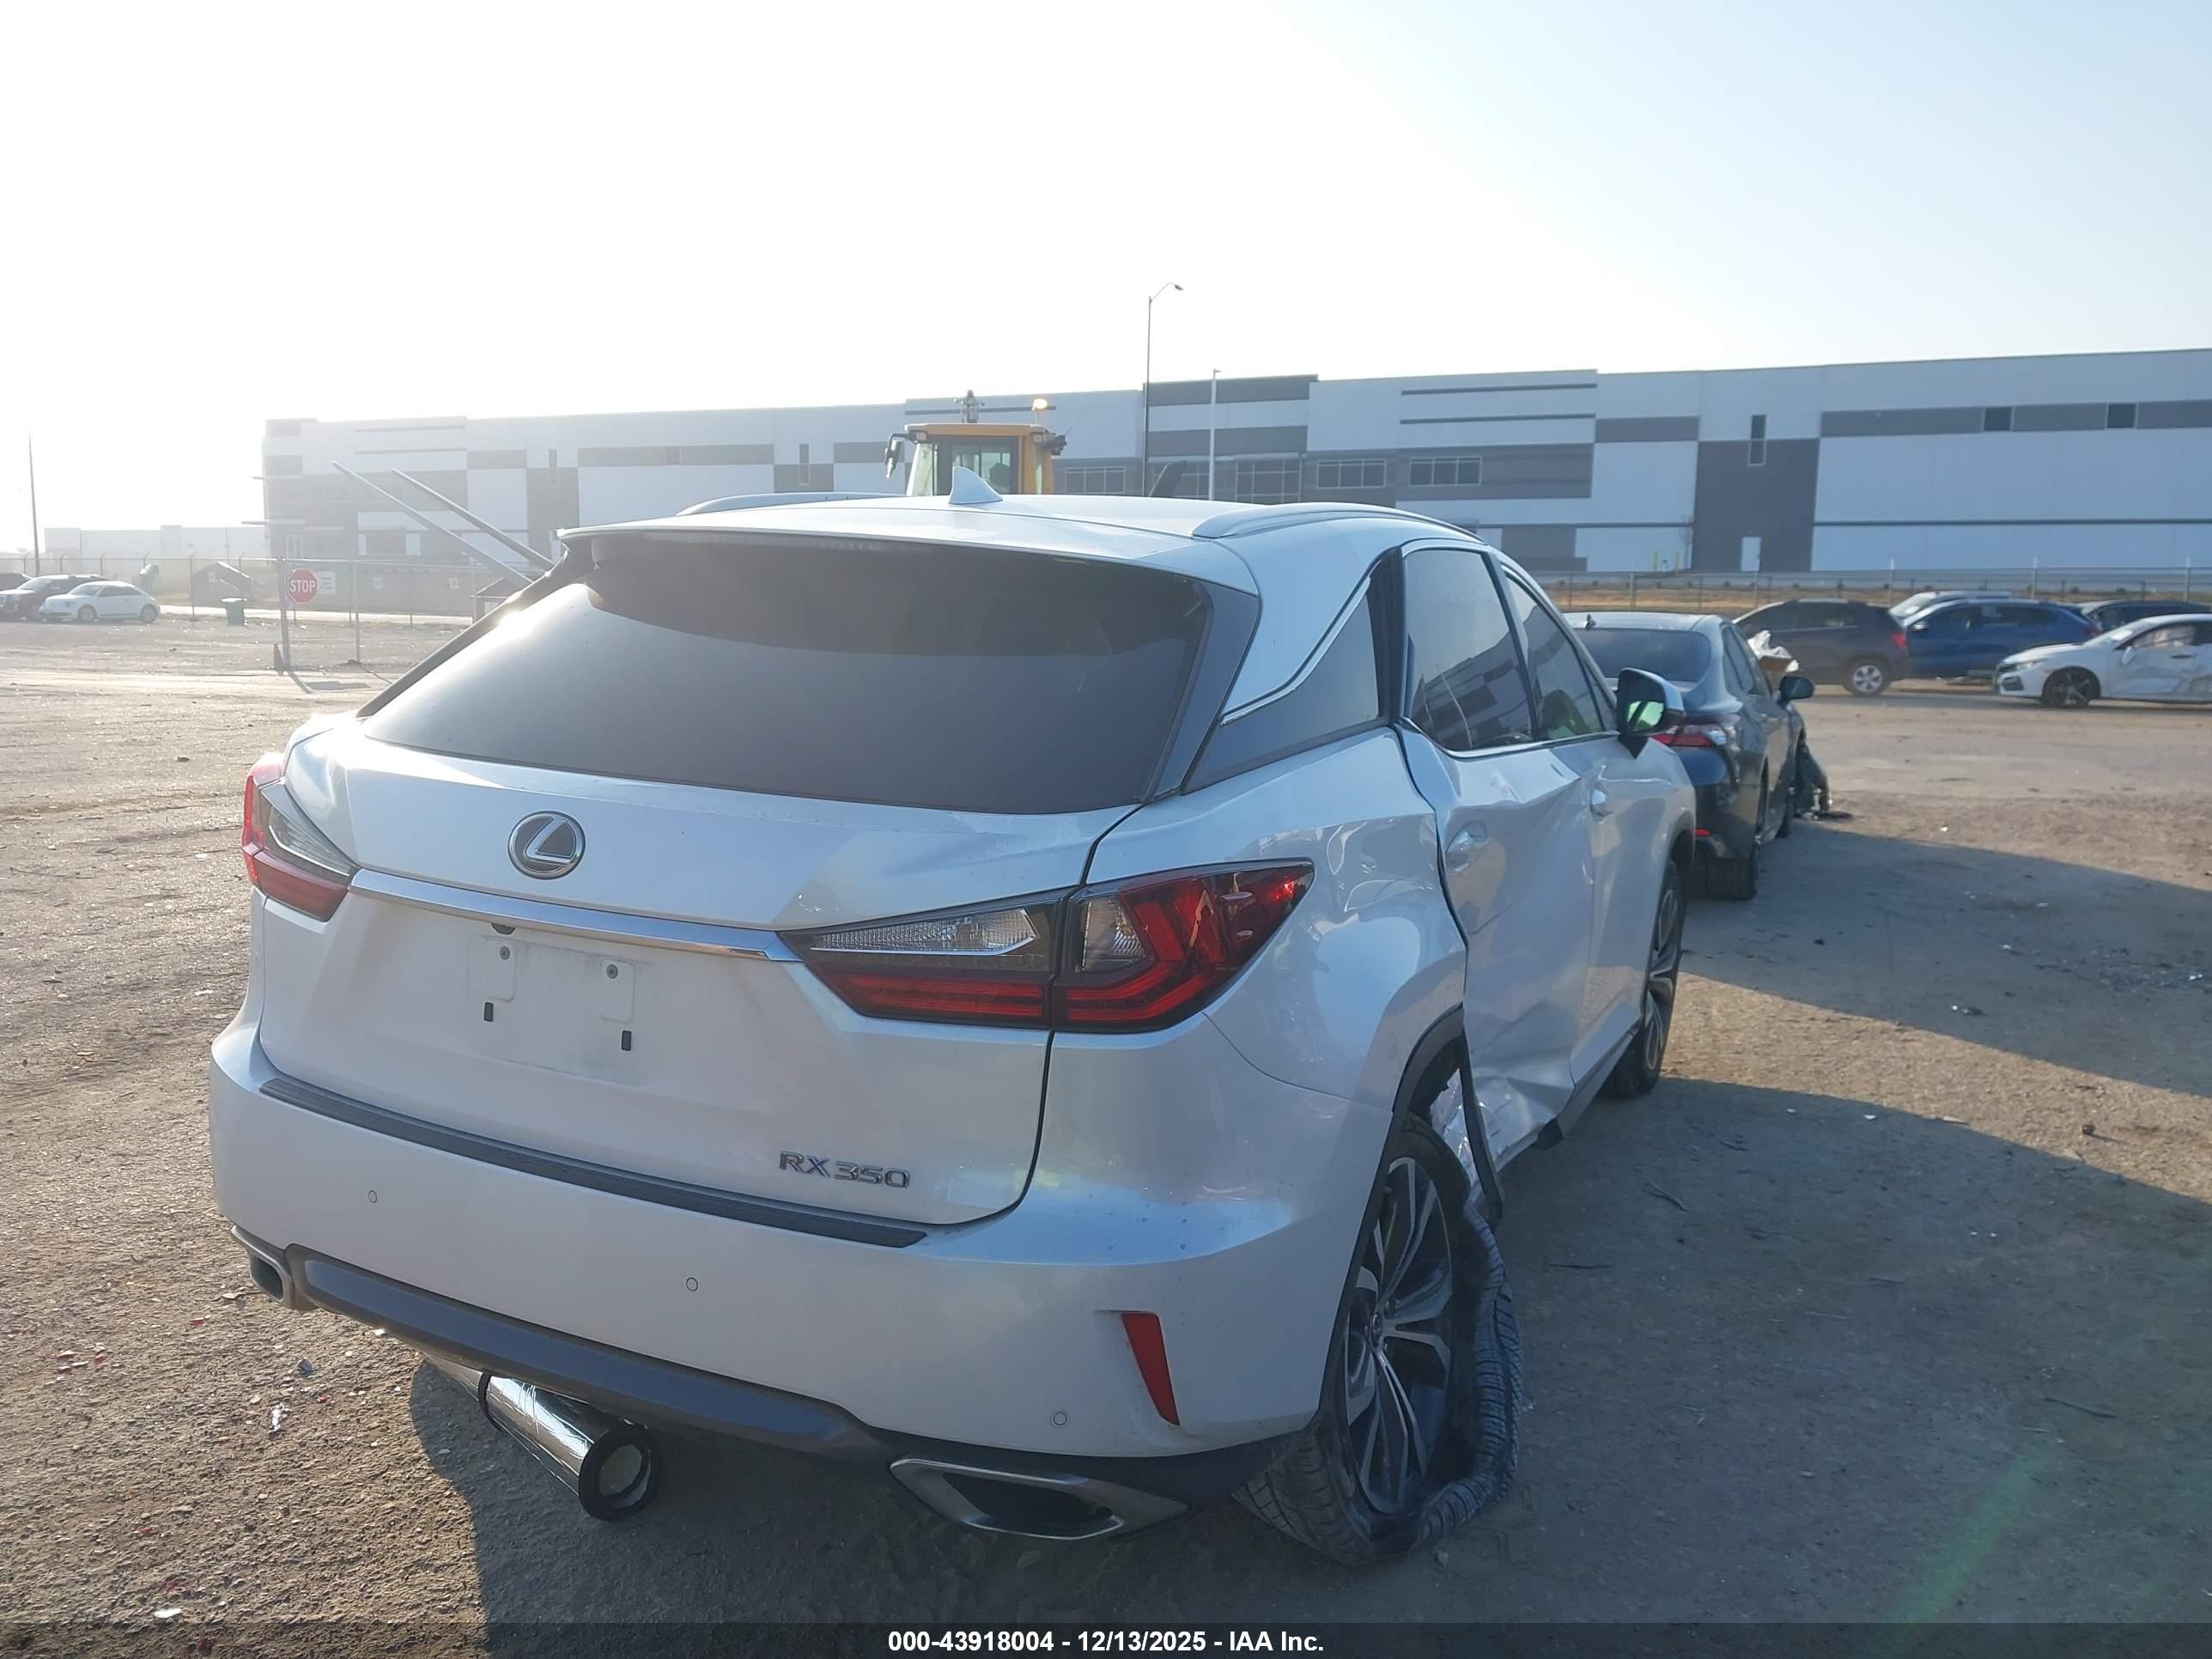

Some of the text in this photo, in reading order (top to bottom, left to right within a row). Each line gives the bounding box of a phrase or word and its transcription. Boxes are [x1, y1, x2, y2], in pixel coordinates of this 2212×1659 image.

[289, 580, 316, 592] STOP
[779, 1151, 910, 1188] RX 350
